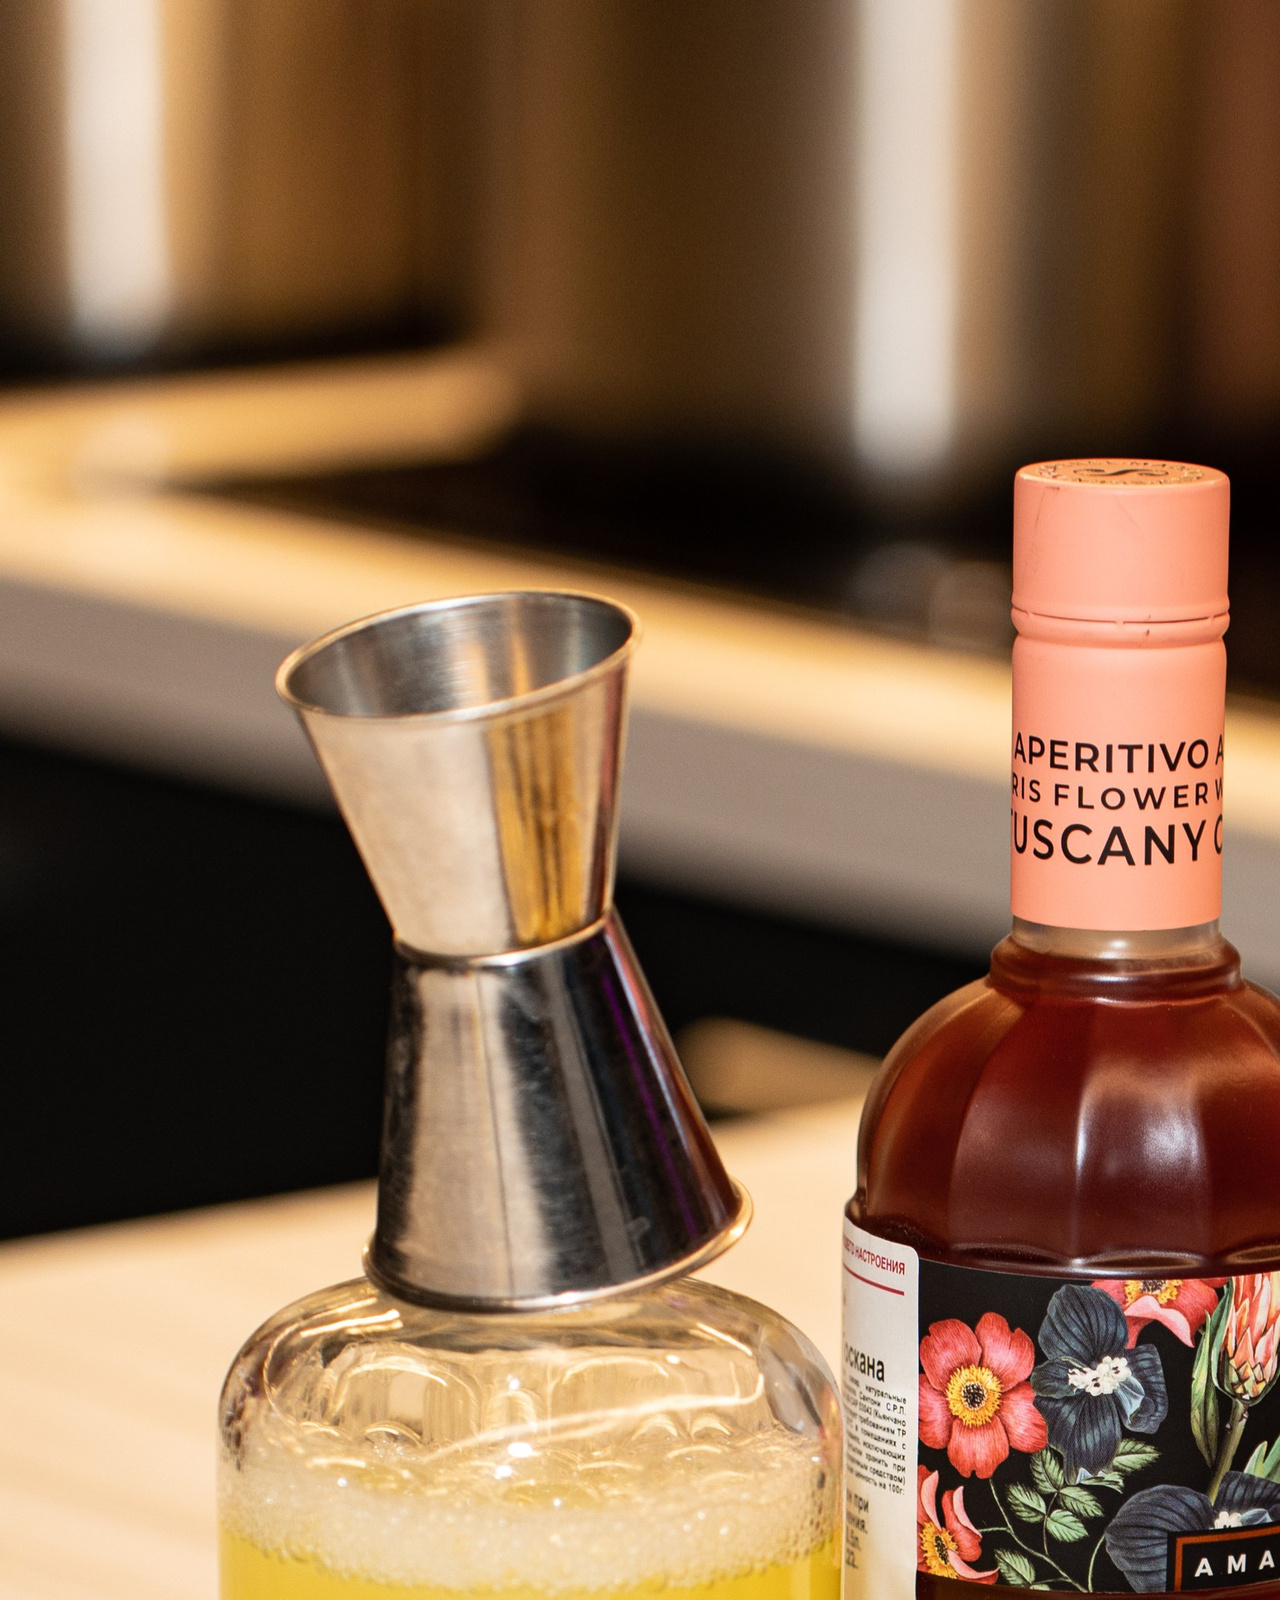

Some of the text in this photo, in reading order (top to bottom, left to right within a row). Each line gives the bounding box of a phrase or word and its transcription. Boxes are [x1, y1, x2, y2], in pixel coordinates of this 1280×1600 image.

[1014, 731, 1209, 774] APERITIVO
[1054, 782, 1209, 811] FLOWER
[1011, 809, 1207, 867] USCANY
[855, 1245, 906, 1276] НАСТРОЕНИЯ
[865, 1384, 907, 1405] натуральные
[897, 1427, 907, 1438] ТР
[892, 1462, 907, 1473] при
